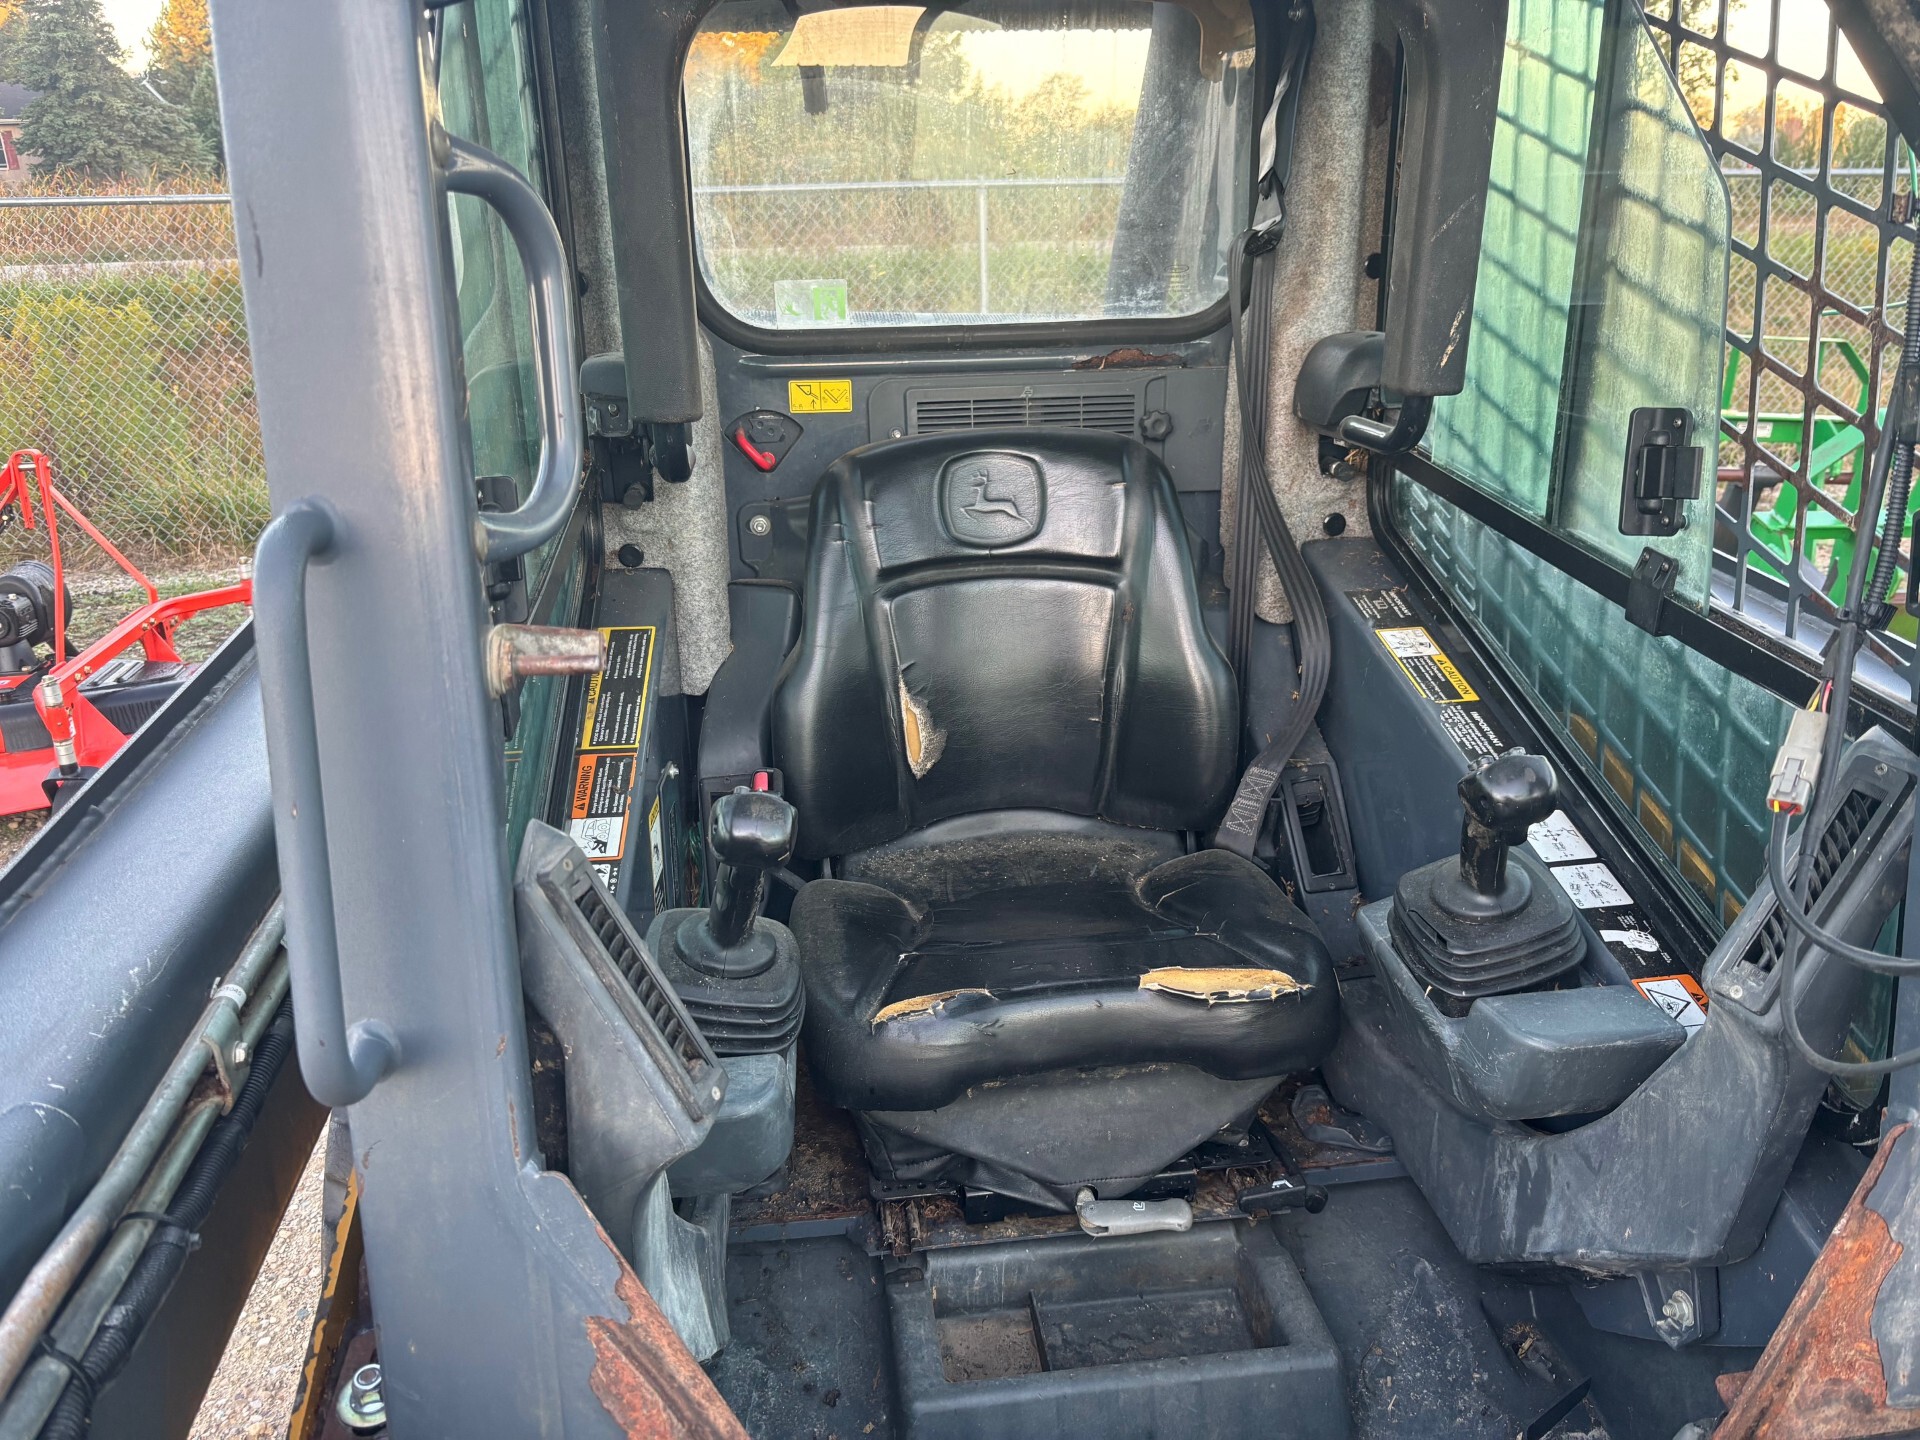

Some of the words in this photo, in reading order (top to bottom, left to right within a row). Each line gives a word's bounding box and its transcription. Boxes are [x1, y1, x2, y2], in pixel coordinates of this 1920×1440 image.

[1443, 665, 1472, 695] CAUTION
[1470, 711, 1504, 747] IMPORTANT
[576, 765, 592, 801] WARNING
